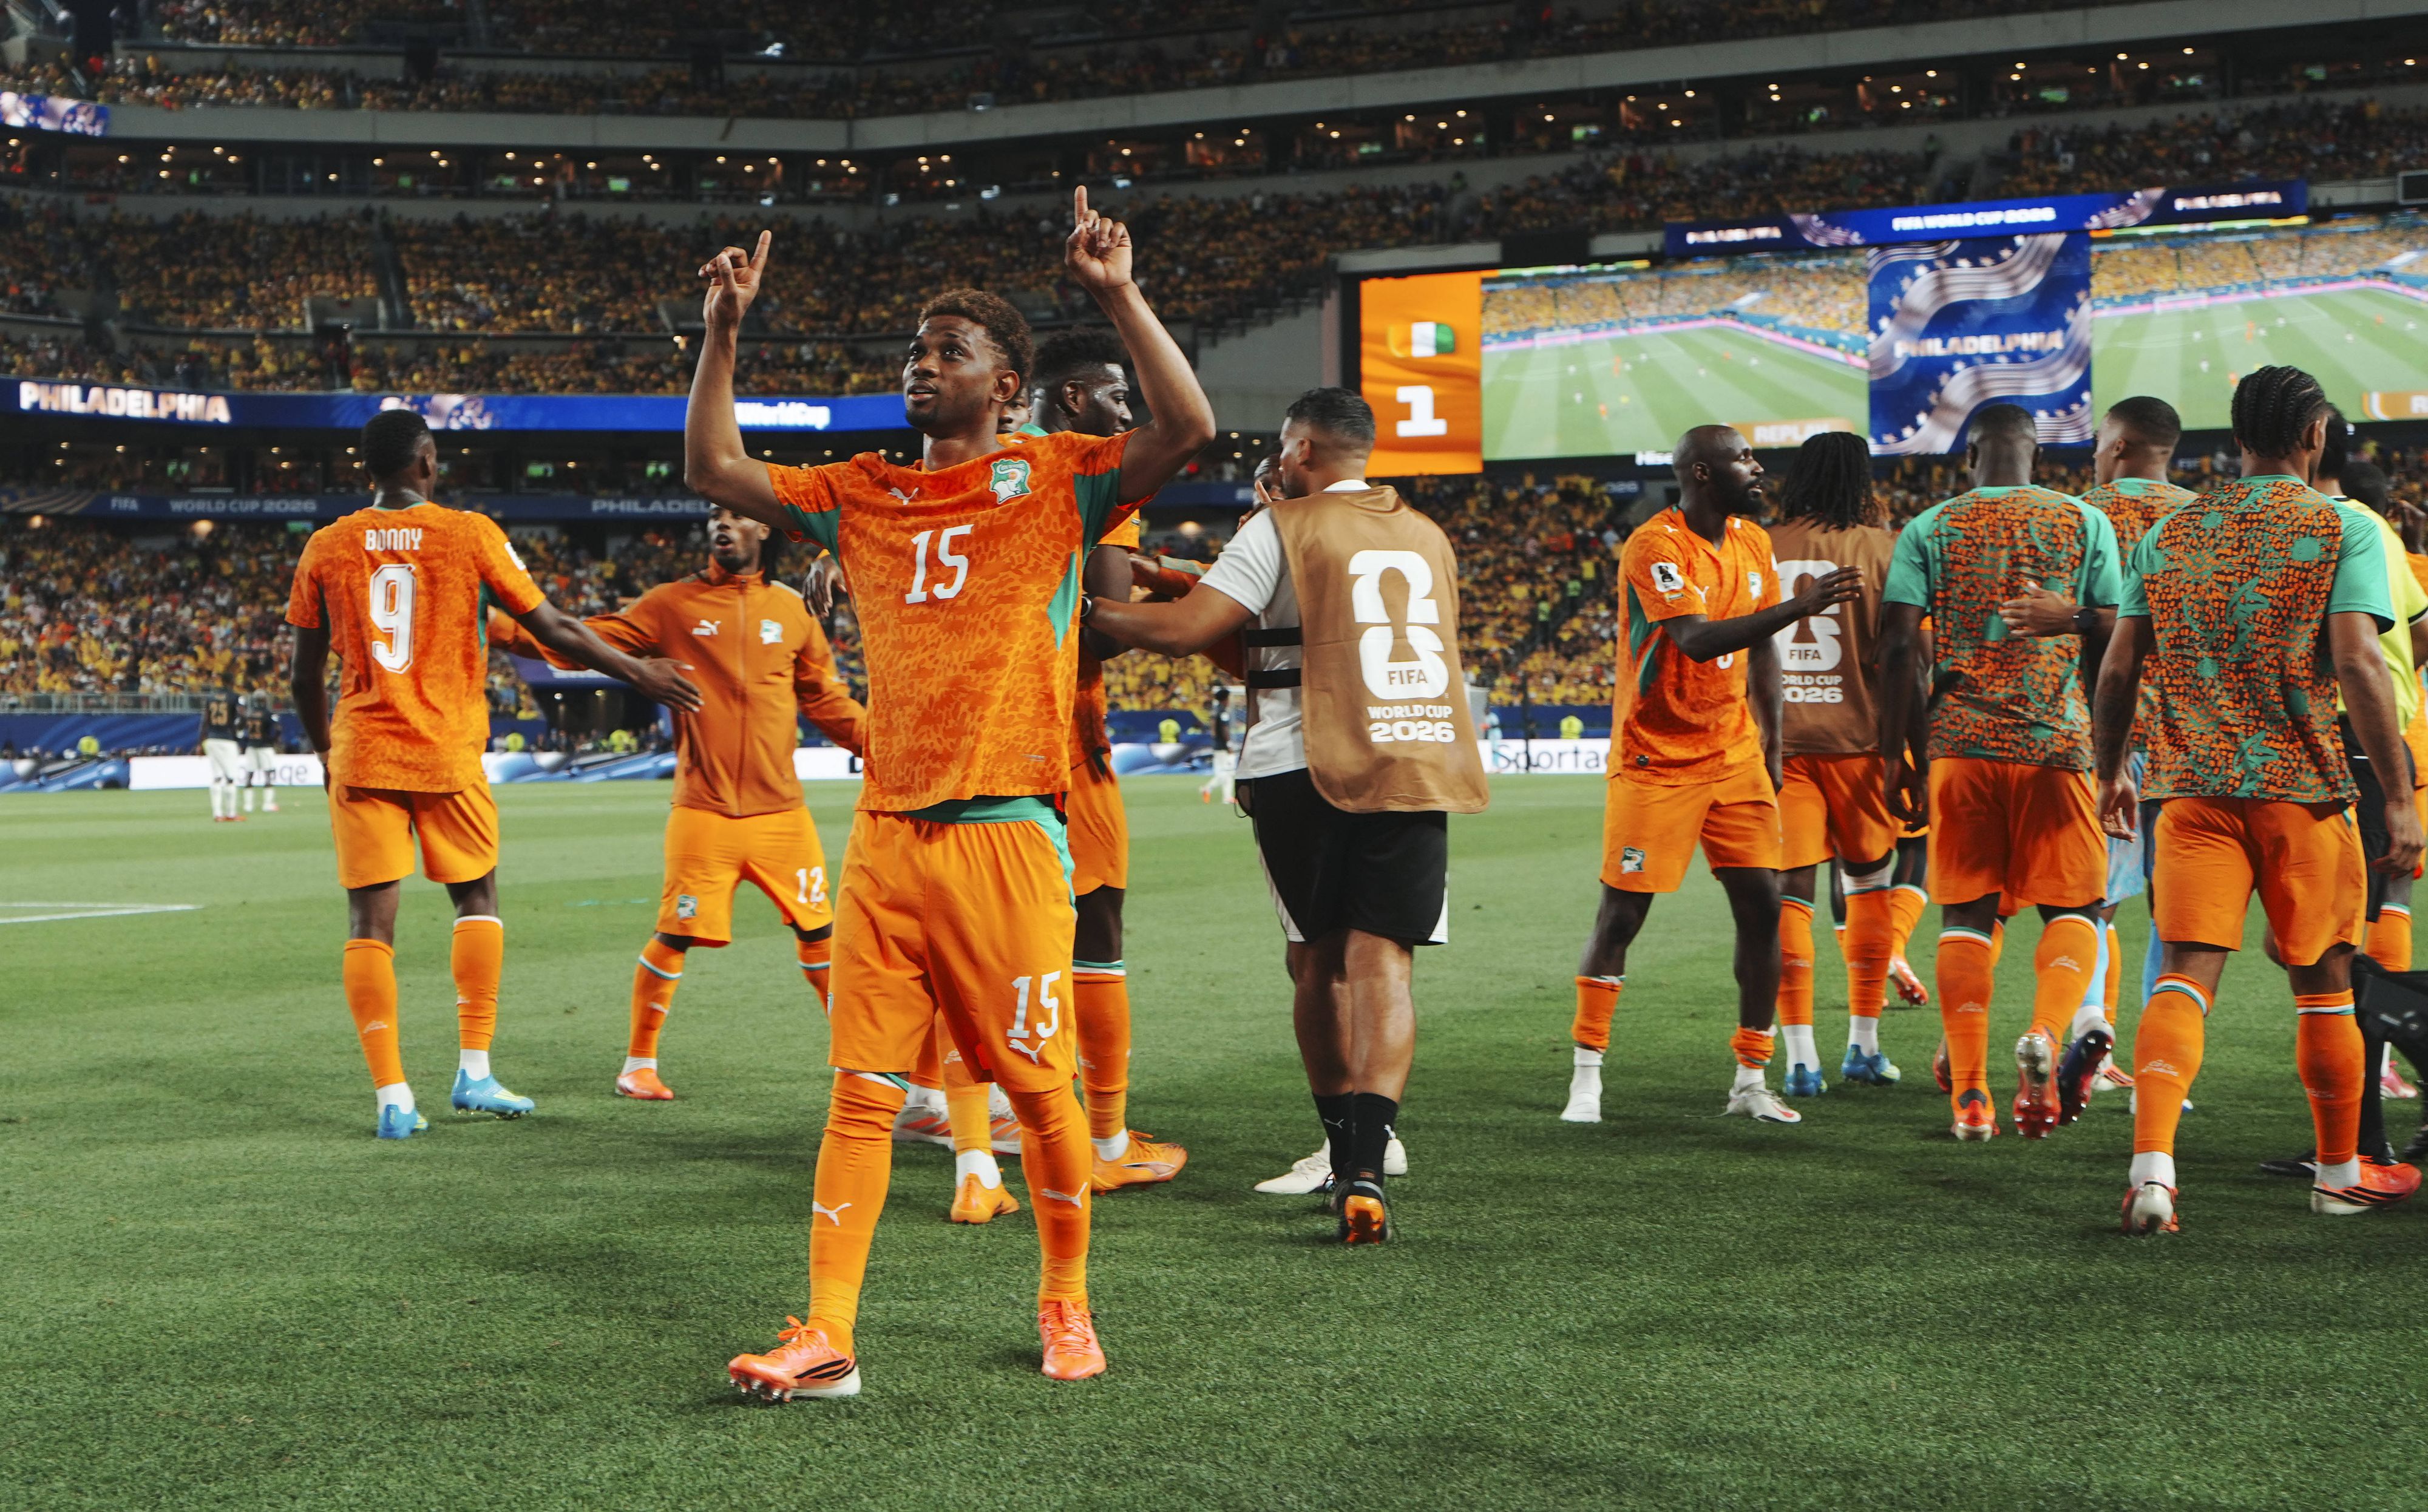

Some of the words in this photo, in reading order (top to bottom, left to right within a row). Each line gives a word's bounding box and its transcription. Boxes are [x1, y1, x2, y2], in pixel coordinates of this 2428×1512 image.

[1891, 215, 1923, 231] FIFA
[1923, 212, 1974, 228] WORLD
[1975, 210, 2003, 225] CUP
[1894, 328, 2063, 358] PHILADELPHIA
[19, 381, 231, 423] PHILADELPHIA
[1397, 385, 1447, 437] 1
[734, 402, 830, 430] WorldCup
[110, 497, 139, 511] FIFA
[171, 500, 225, 513] WORLD
[229, 500, 260, 512] CUP
[262, 500, 317, 513] 2026
[365, 527, 422, 551] BONNY
[905, 524, 974, 605] 15
[370, 563, 416, 674] 9
[1789, 649, 1822, 660] FIFA
[1388, 669, 1428, 685] FIFA
[1782, 675, 1815, 686] ORLD
[1816, 675, 1843, 685] CUP
[1782, 687, 1843, 703] 026
[1366, 705, 1425, 719] WORLD
[1426, 705, 1453, 719] CUP
[1369, 720, 1456, 743] 2026
[795, 866, 826, 903] 12
[1006, 971, 1062, 1039] 15
